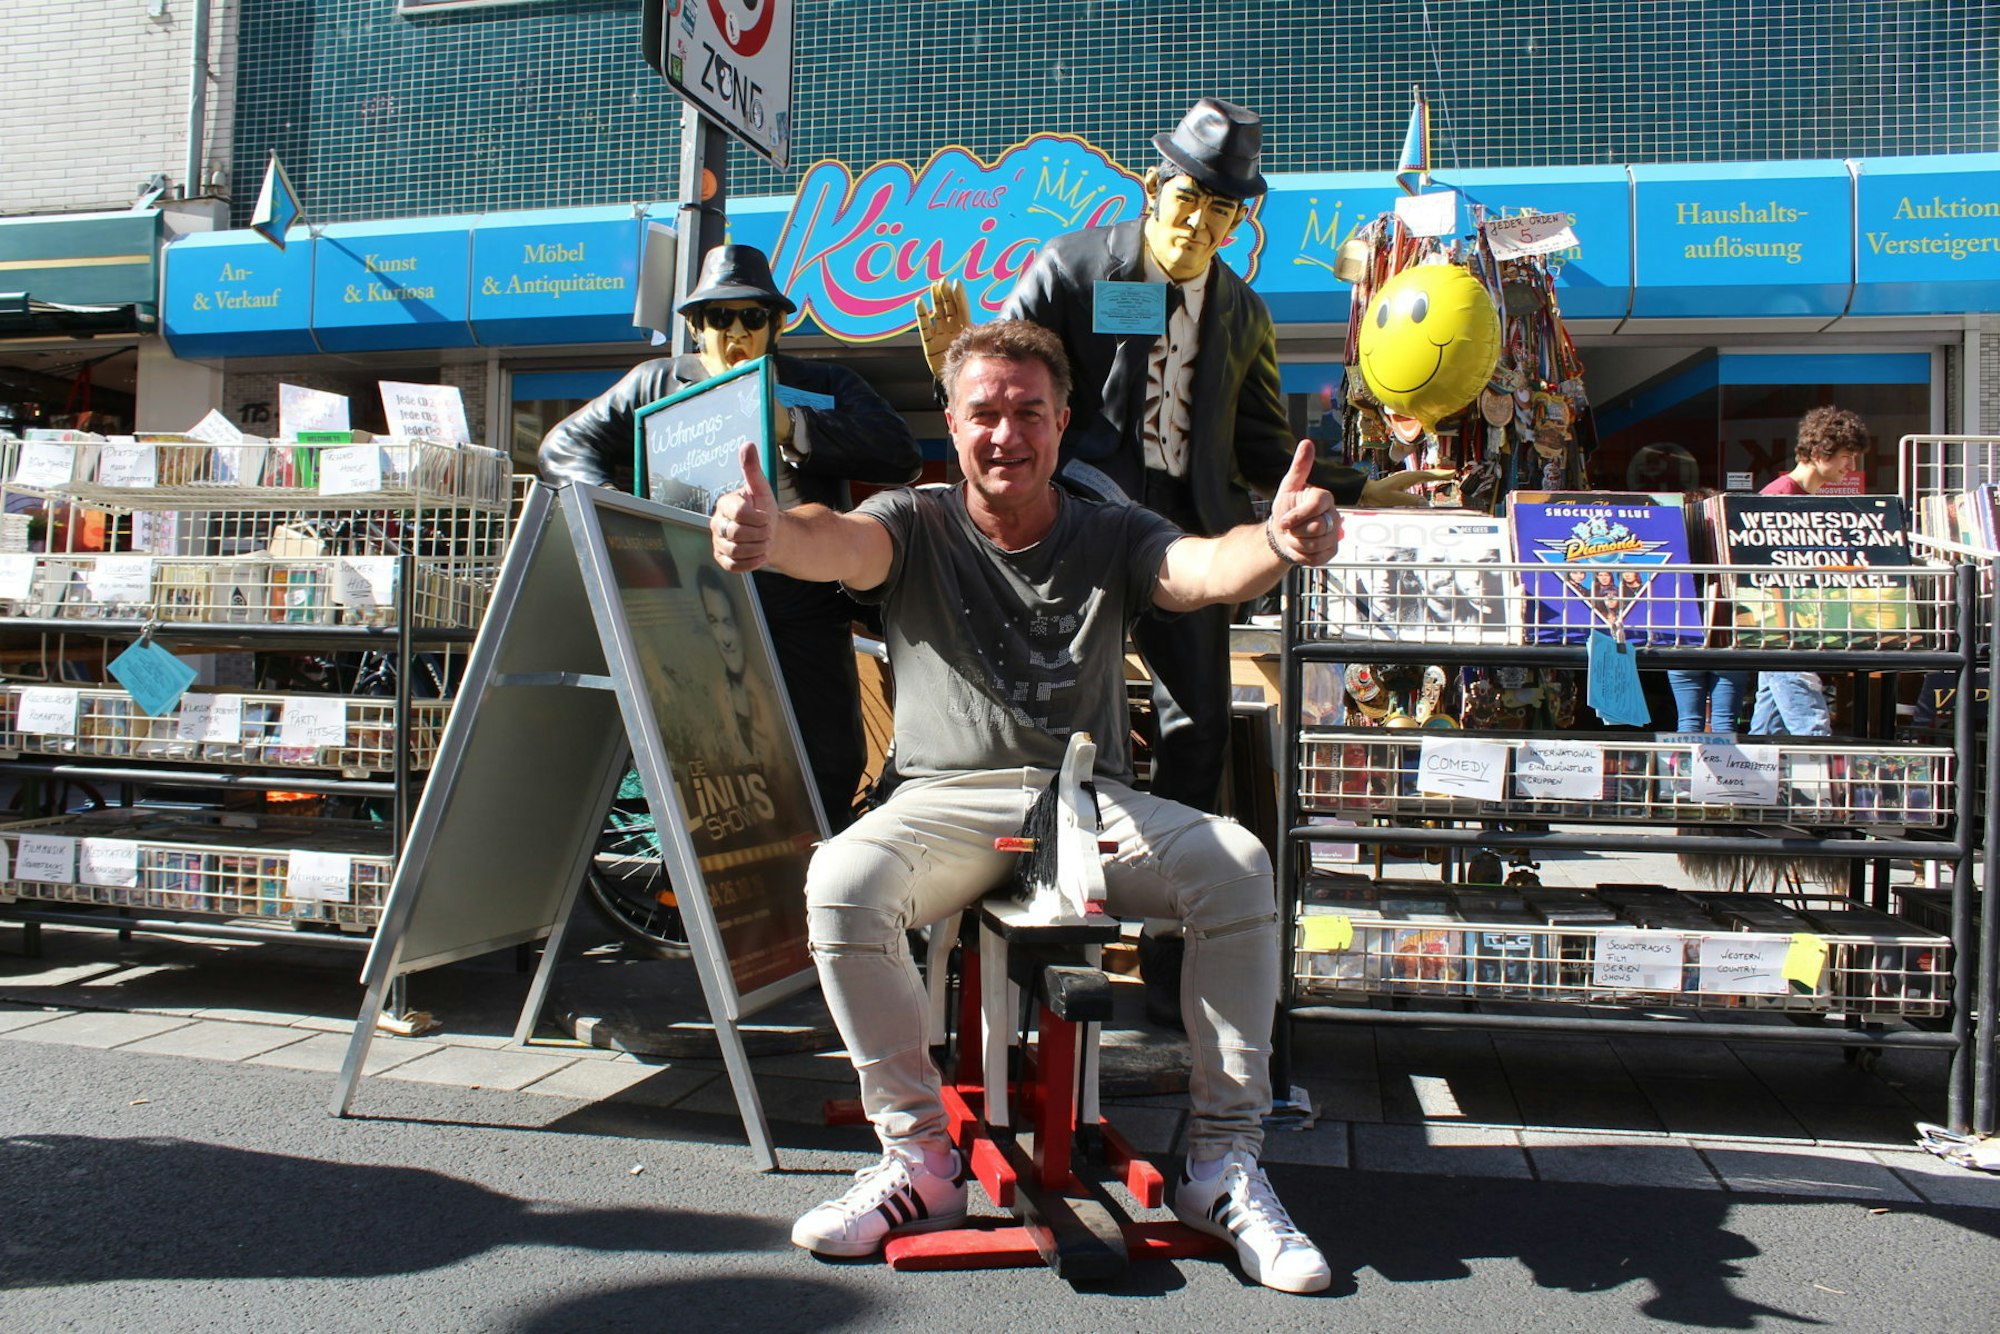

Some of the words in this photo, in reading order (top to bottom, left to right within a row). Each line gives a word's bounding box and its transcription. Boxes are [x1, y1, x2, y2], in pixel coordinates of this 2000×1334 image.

[927, 168, 1025, 211] Linus'
[1676, 201, 1808, 225] Haushalts-
[1490, 217, 1523, 236] JEDER
[1530, 214, 1560, 226] ORDEN
[523, 242, 585, 264] Möbel
[1685, 235, 1802, 264] auflösung
[219, 263, 253, 282] An-
[364, 254, 417, 273] Kunst
[343, 284, 362, 304] &
[366, 281, 436, 302] Kuriosa
[481, 275, 501, 295] &
[506, 272, 626, 299] Antiquitäten
[192, 292, 210, 311] &
[215, 287, 283, 309] Verkauf
[1544, 507, 1613, 517] SHOCKING
[1618, 509, 1651, 519] BLUE
[1740, 512, 1885, 531] WEDNESDAY
[1565, 533, 1645, 561] Diamonds
[1729, 529, 1848, 548] MORNING,
[1771, 551, 1850, 567] SIMON
[1852, 550, 1870, 567] &
[287, 709, 319, 727] PARTY
[1530, 749, 1597, 759] INTERNATIONAL
[1426, 754, 1490, 780] COMEDY
[1606, 953, 1627, 963] FILM
[1601, 973, 1631, 982] SHOWS
[1602, 963, 1641, 973] SERIEN
[1716, 964, 1758, 975] COUNTRY
